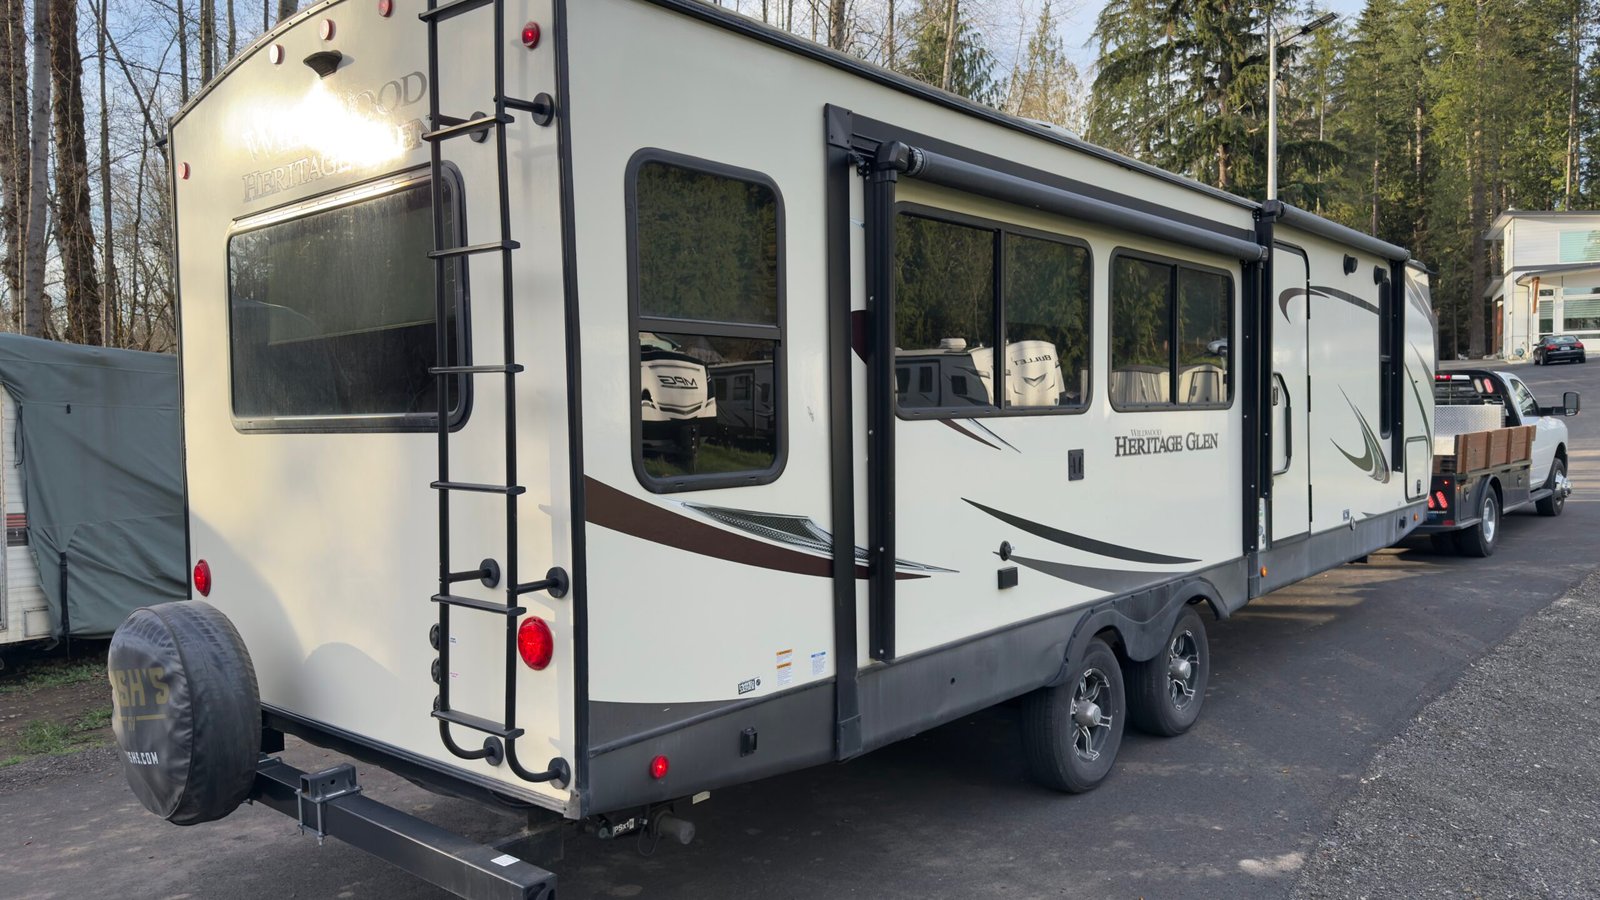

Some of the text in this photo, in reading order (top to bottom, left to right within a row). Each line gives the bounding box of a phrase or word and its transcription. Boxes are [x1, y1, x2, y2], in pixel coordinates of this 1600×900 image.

[1130, 428, 1162, 437] WILDWOOD
[1115, 432, 1219, 457] HERITAGE GLEN
